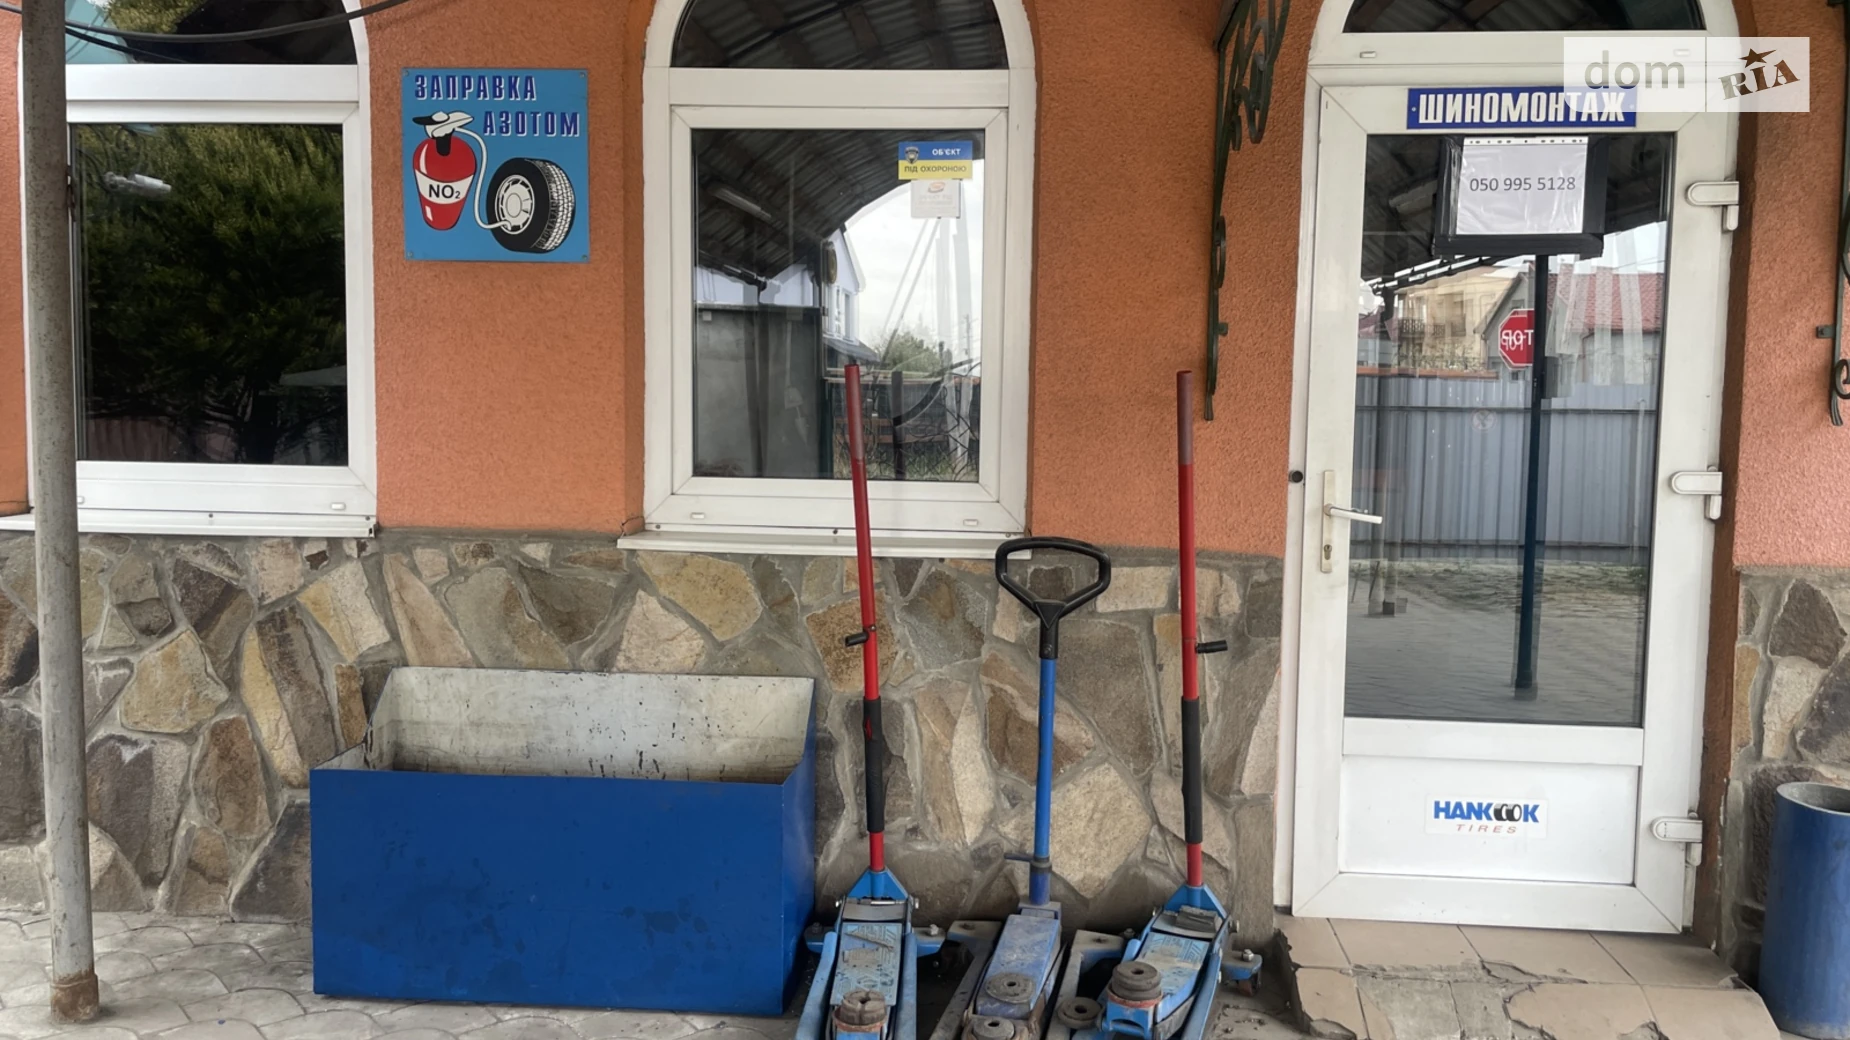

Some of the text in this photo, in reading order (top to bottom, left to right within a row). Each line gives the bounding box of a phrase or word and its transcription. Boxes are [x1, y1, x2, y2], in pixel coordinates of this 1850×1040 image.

[414, 74, 537, 101] ЗАПРАВКА
[1418, 91, 1626, 124] ШИНОМОНТАЖ
[483, 110, 580, 137] АЗОТОМ
[904, 165, 967, 173] ПІД ОХОРОНОЮ
[1469, 176, 1576, 191] 050 995 5128
[1433, 800, 1540, 824] HANKOOK
[1455, 823, 1517, 834] TIRES
